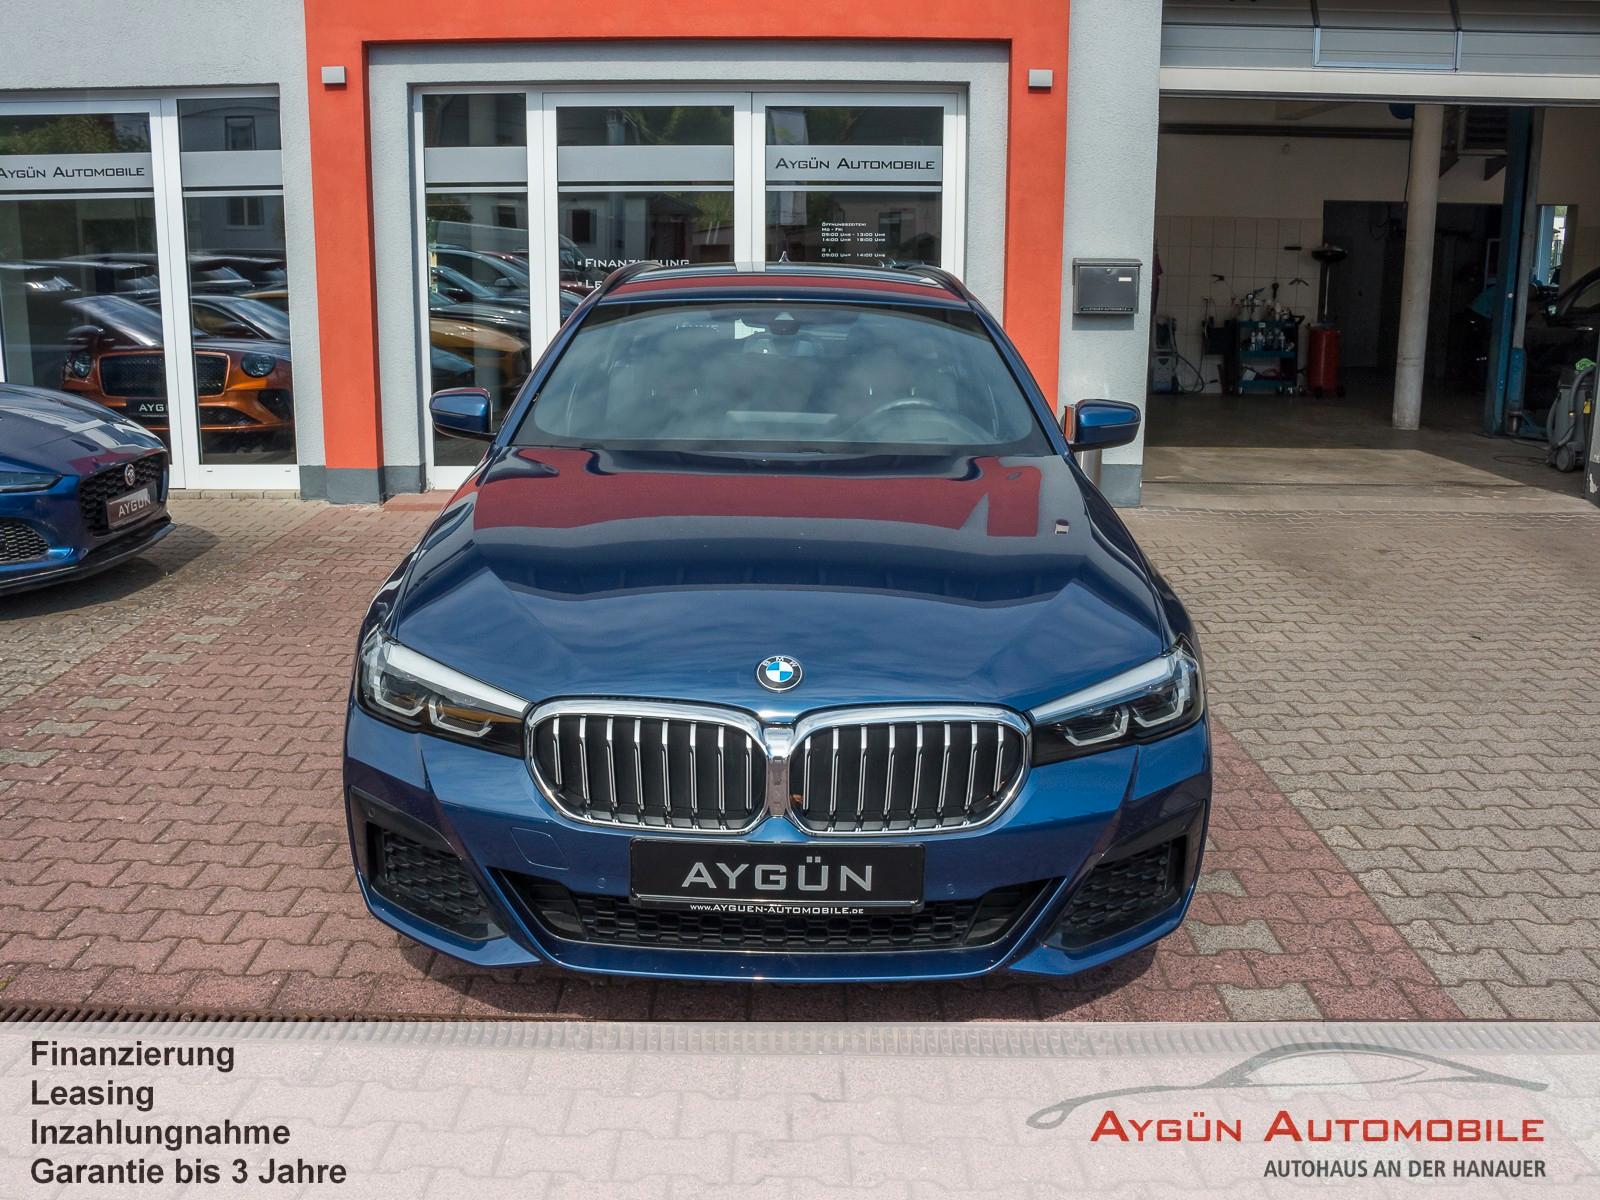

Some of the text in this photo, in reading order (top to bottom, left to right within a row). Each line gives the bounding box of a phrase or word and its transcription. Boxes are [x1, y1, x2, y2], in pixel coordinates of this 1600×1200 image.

[776, 157, 936, 170] AYGÜN AUTOMOBILE
[52, 167, 145, 178] AUTOMOBILE
[139, 403, 168, 412] AYG
[681, 856, 873, 892] AYGÜN
